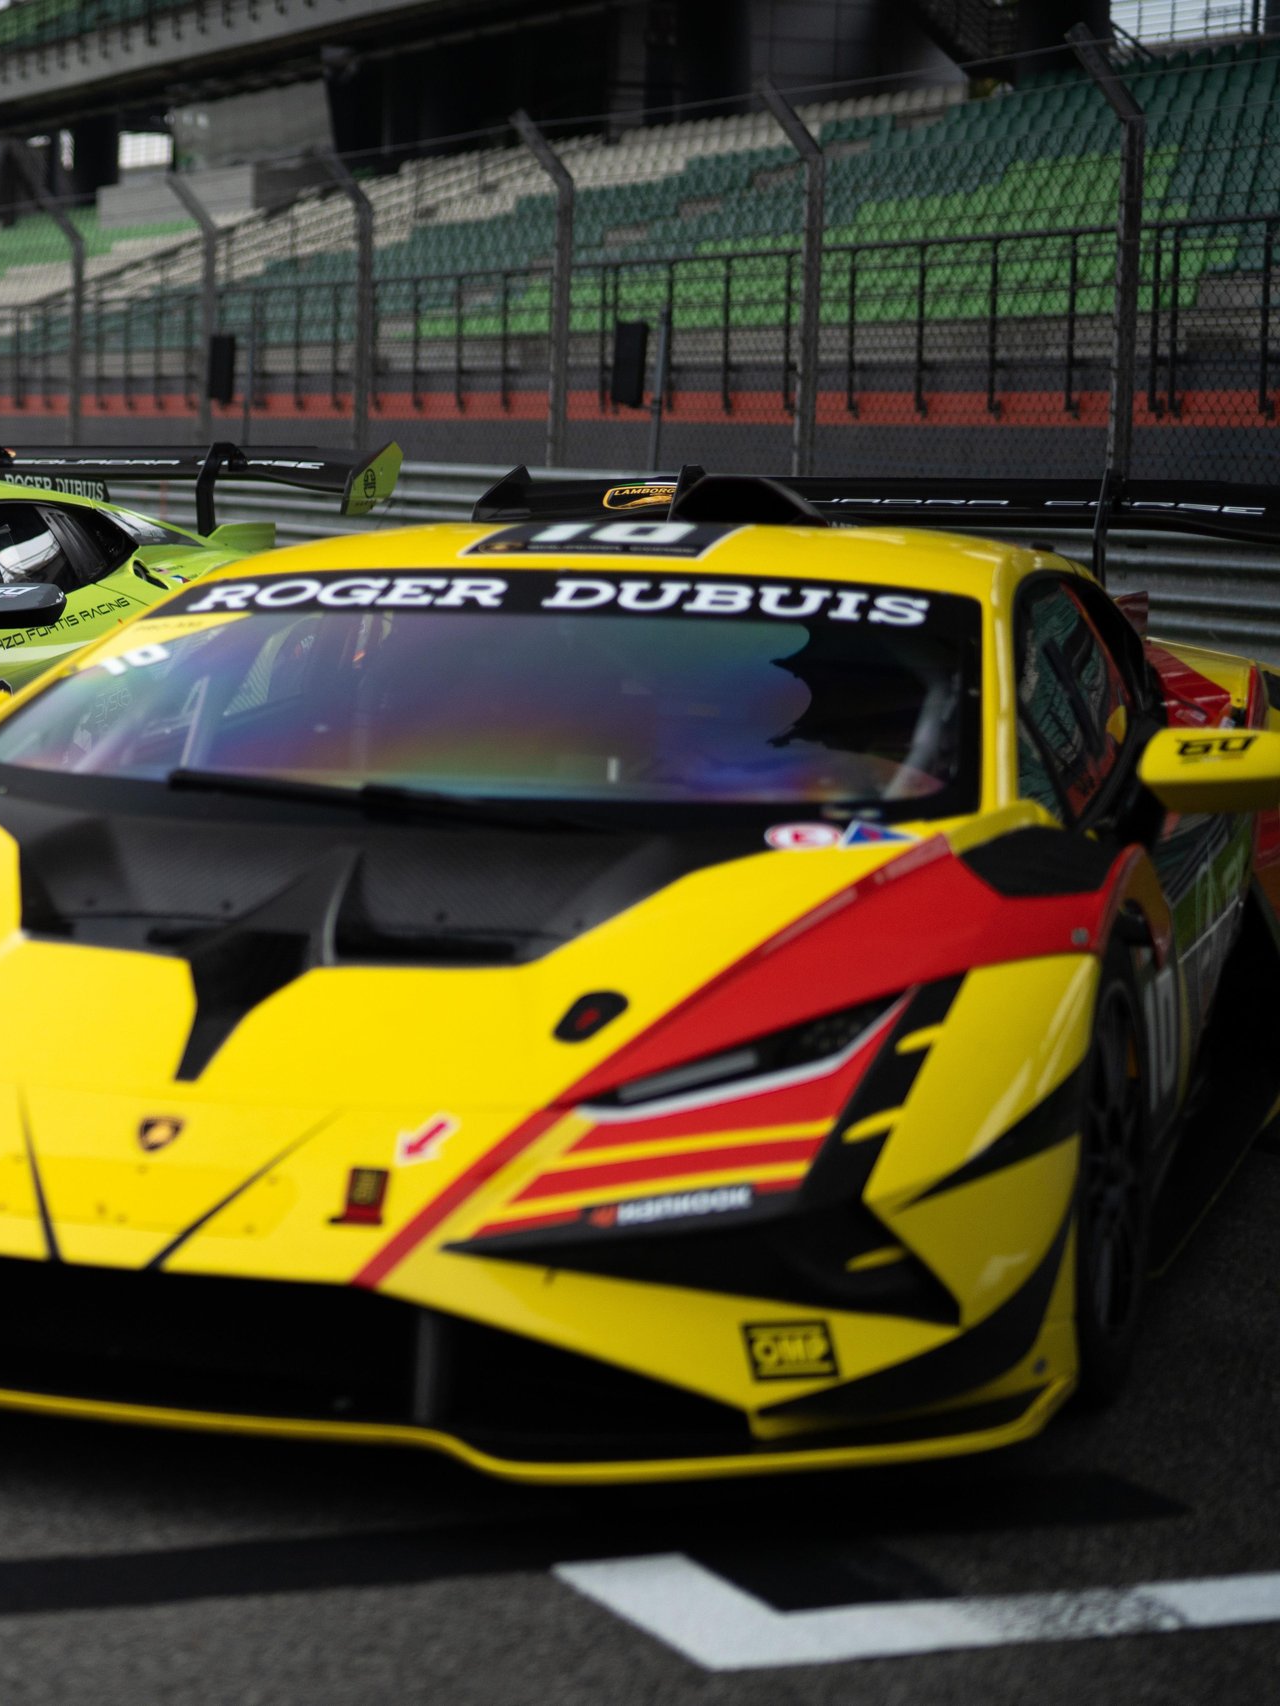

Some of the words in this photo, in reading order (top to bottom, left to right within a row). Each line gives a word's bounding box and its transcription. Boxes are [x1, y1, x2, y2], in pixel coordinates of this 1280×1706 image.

[528, 522, 698, 544] 10
[79, 597, 131, 623] RACING
[187, 578, 509, 613] ROGER
[541, 579, 930, 627] DUBUIS
[752, 1335, 828, 1365] OMP
